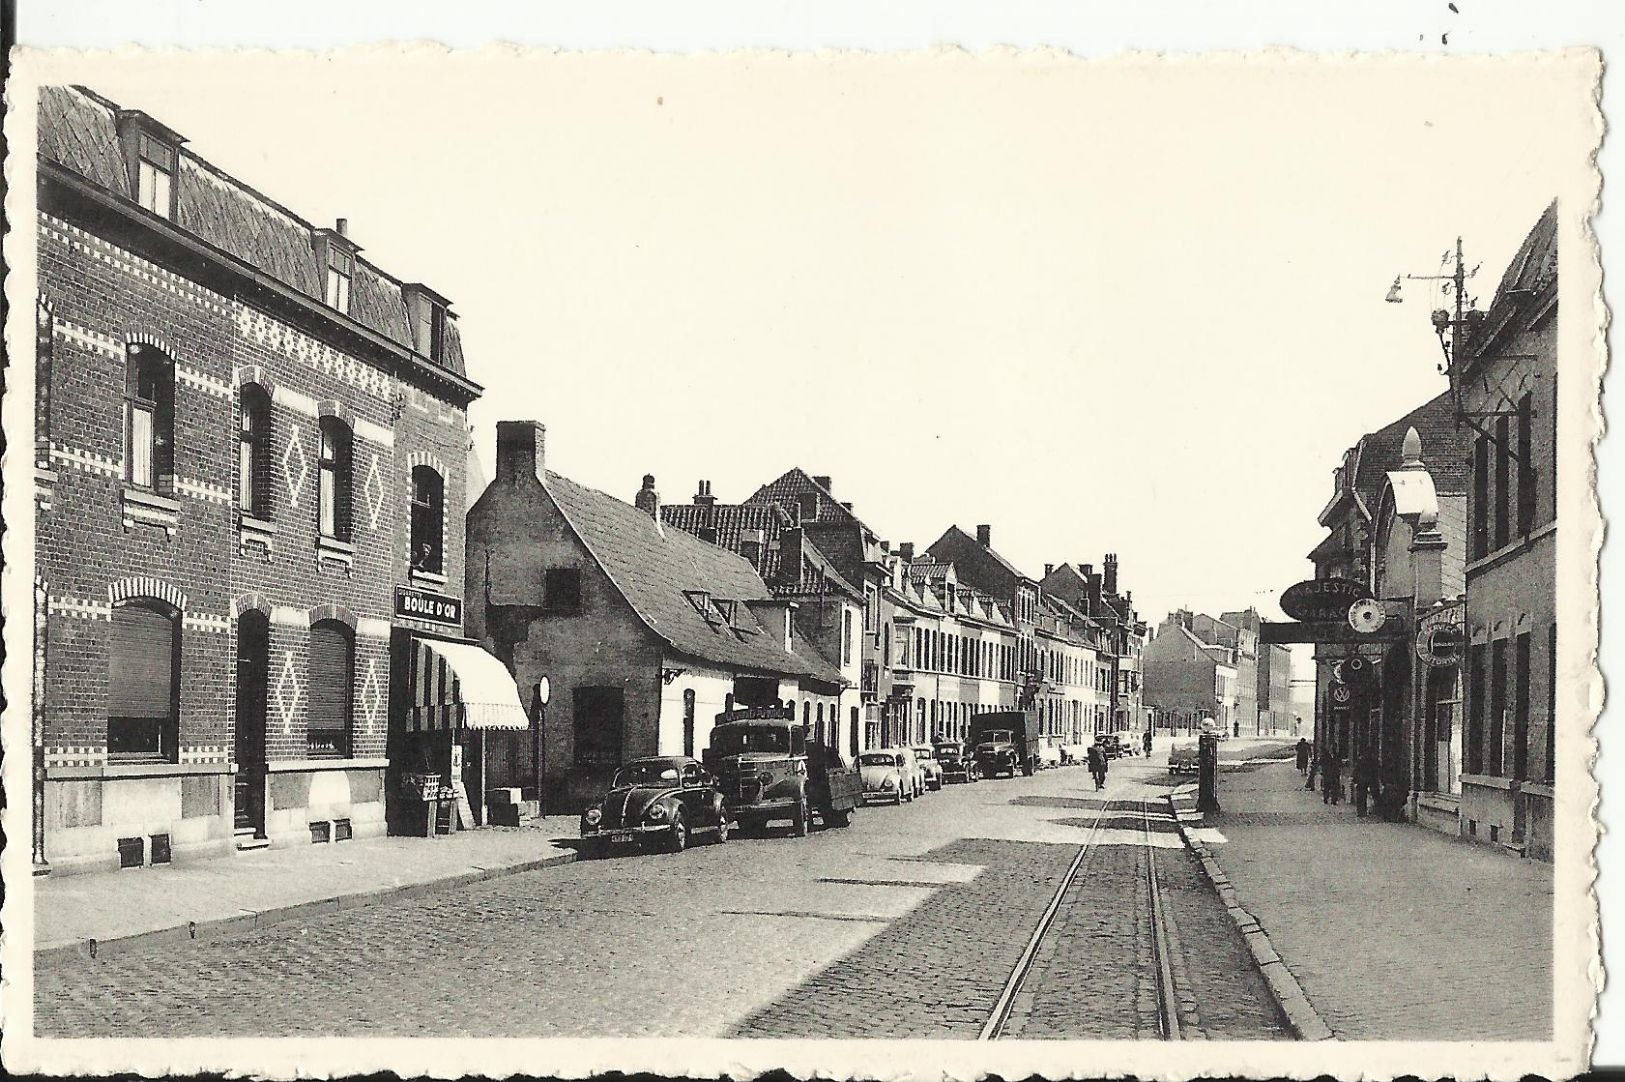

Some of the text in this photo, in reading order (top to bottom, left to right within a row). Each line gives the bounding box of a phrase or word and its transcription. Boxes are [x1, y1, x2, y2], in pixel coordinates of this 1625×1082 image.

[1290, 583, 1361, 597] MAJESTIC
[404, 596, 456, 619] BOULE D'OR
